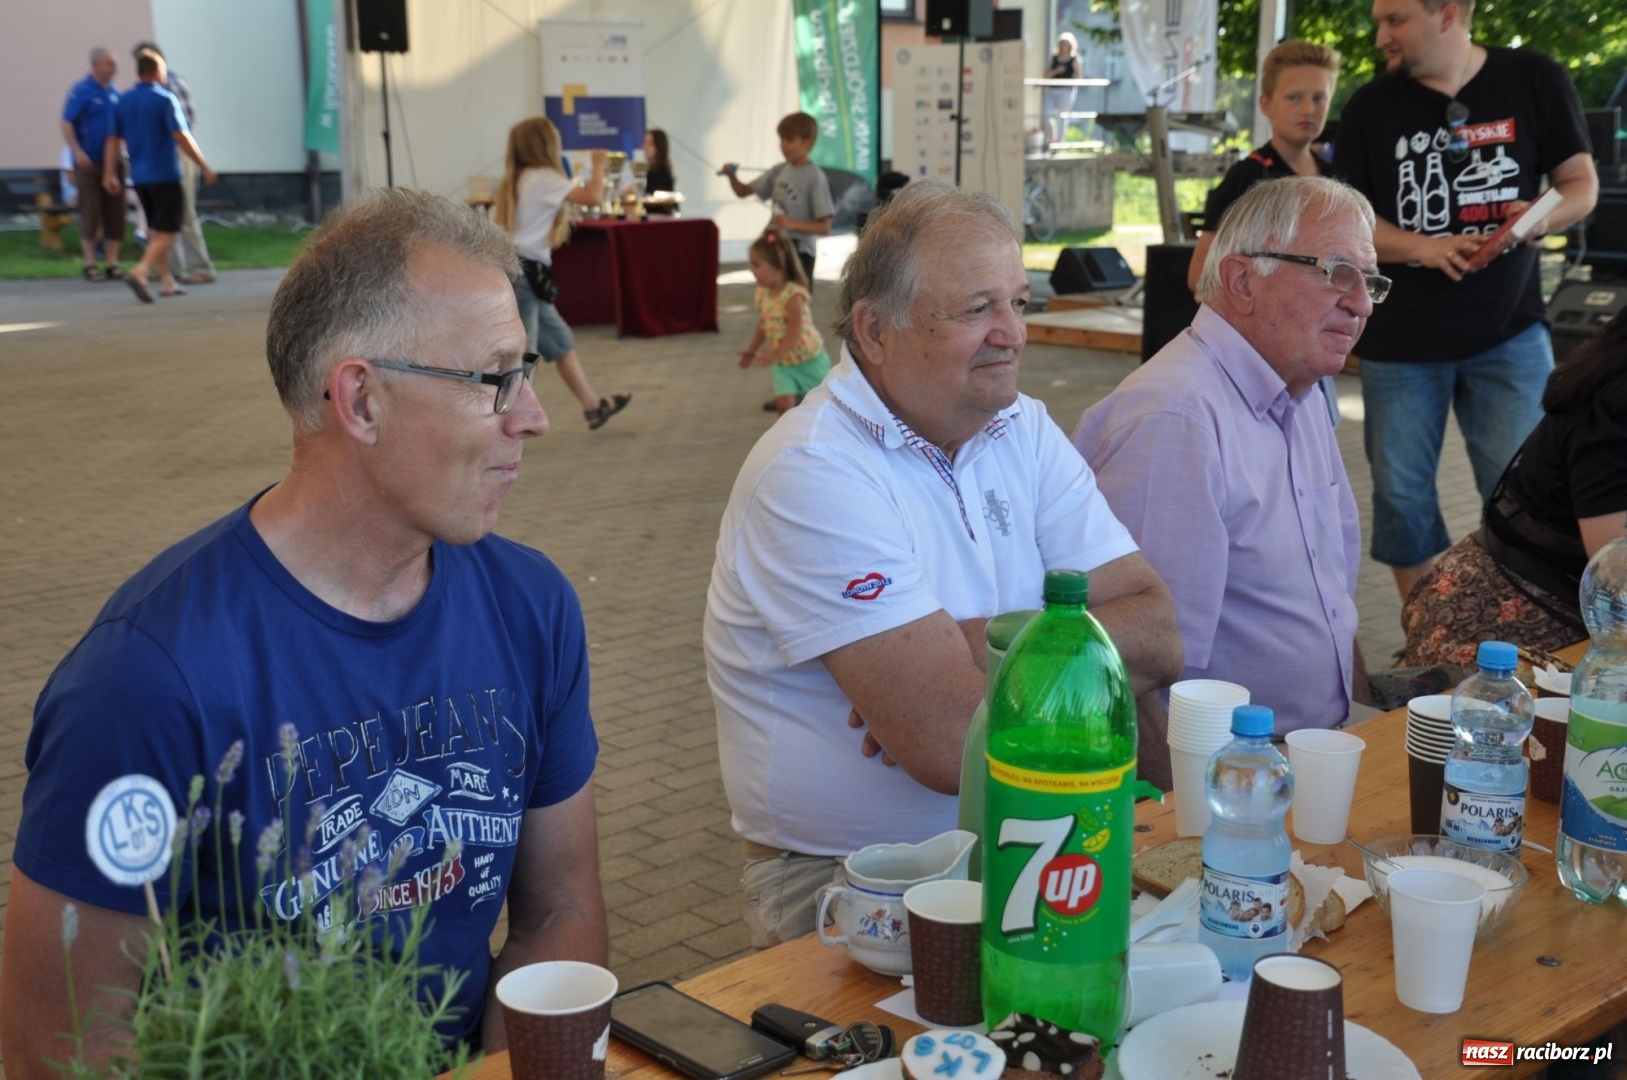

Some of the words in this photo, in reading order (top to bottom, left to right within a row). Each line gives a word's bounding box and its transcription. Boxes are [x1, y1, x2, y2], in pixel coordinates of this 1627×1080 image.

[1458, 205, 1489, 223] 400
[843, 583, 873, 599] LONDYN
[264, 711, 389, 858] PEPE
[395, 688, 527, 779] JEANS
[450, 769, 491, 794] MARK
[1460, 802, 1516, 819] POLARIS
[106, 794, 161, 851] LKS
[317, 802, 364, 847] TRADE
[474, 852, 495, 868] HAND
[479, 868, 490, 879] OF
[468, 875, 502, 897] QUALITY
[1045, 863, 1097, 909] up
[1203, 878, 1256, 904] POLARIS
